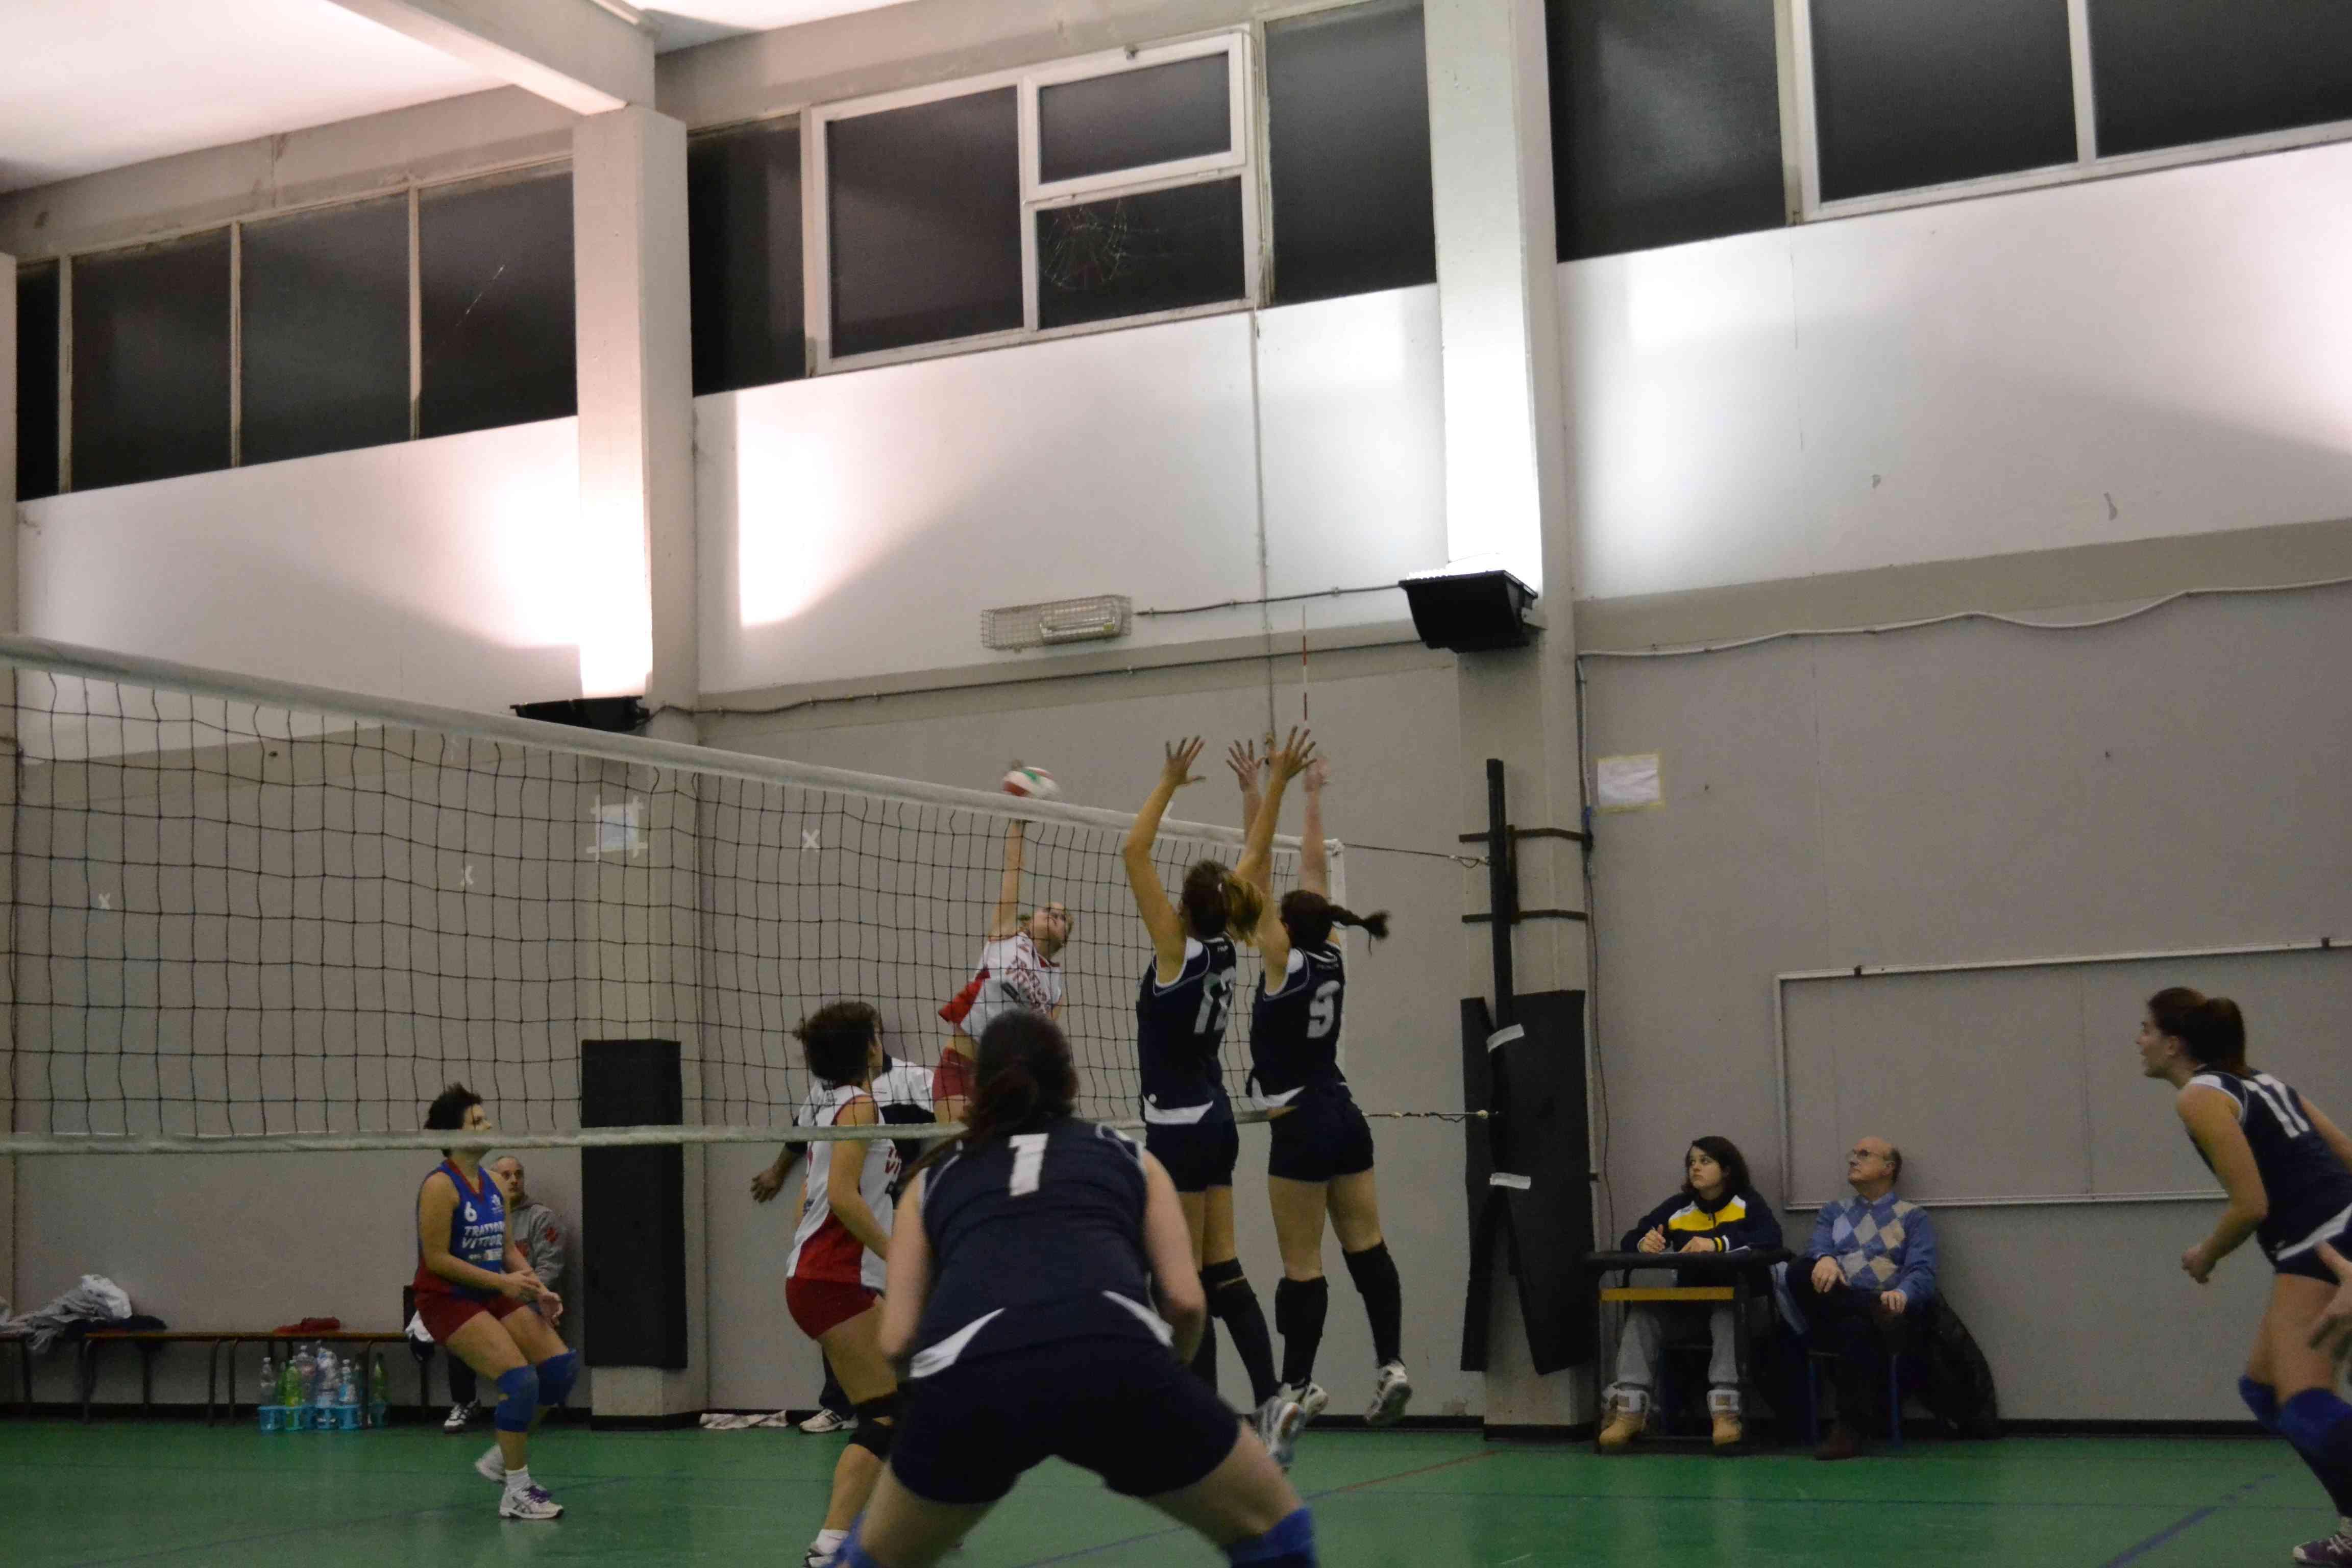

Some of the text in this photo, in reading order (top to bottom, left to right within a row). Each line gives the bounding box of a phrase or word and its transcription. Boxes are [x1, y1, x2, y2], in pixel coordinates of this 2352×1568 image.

[2241, 1073, 2310, 1139] 11
[1008, 1133, 1049, 1196] 1
[464, 1201, 477, 1222] 6
